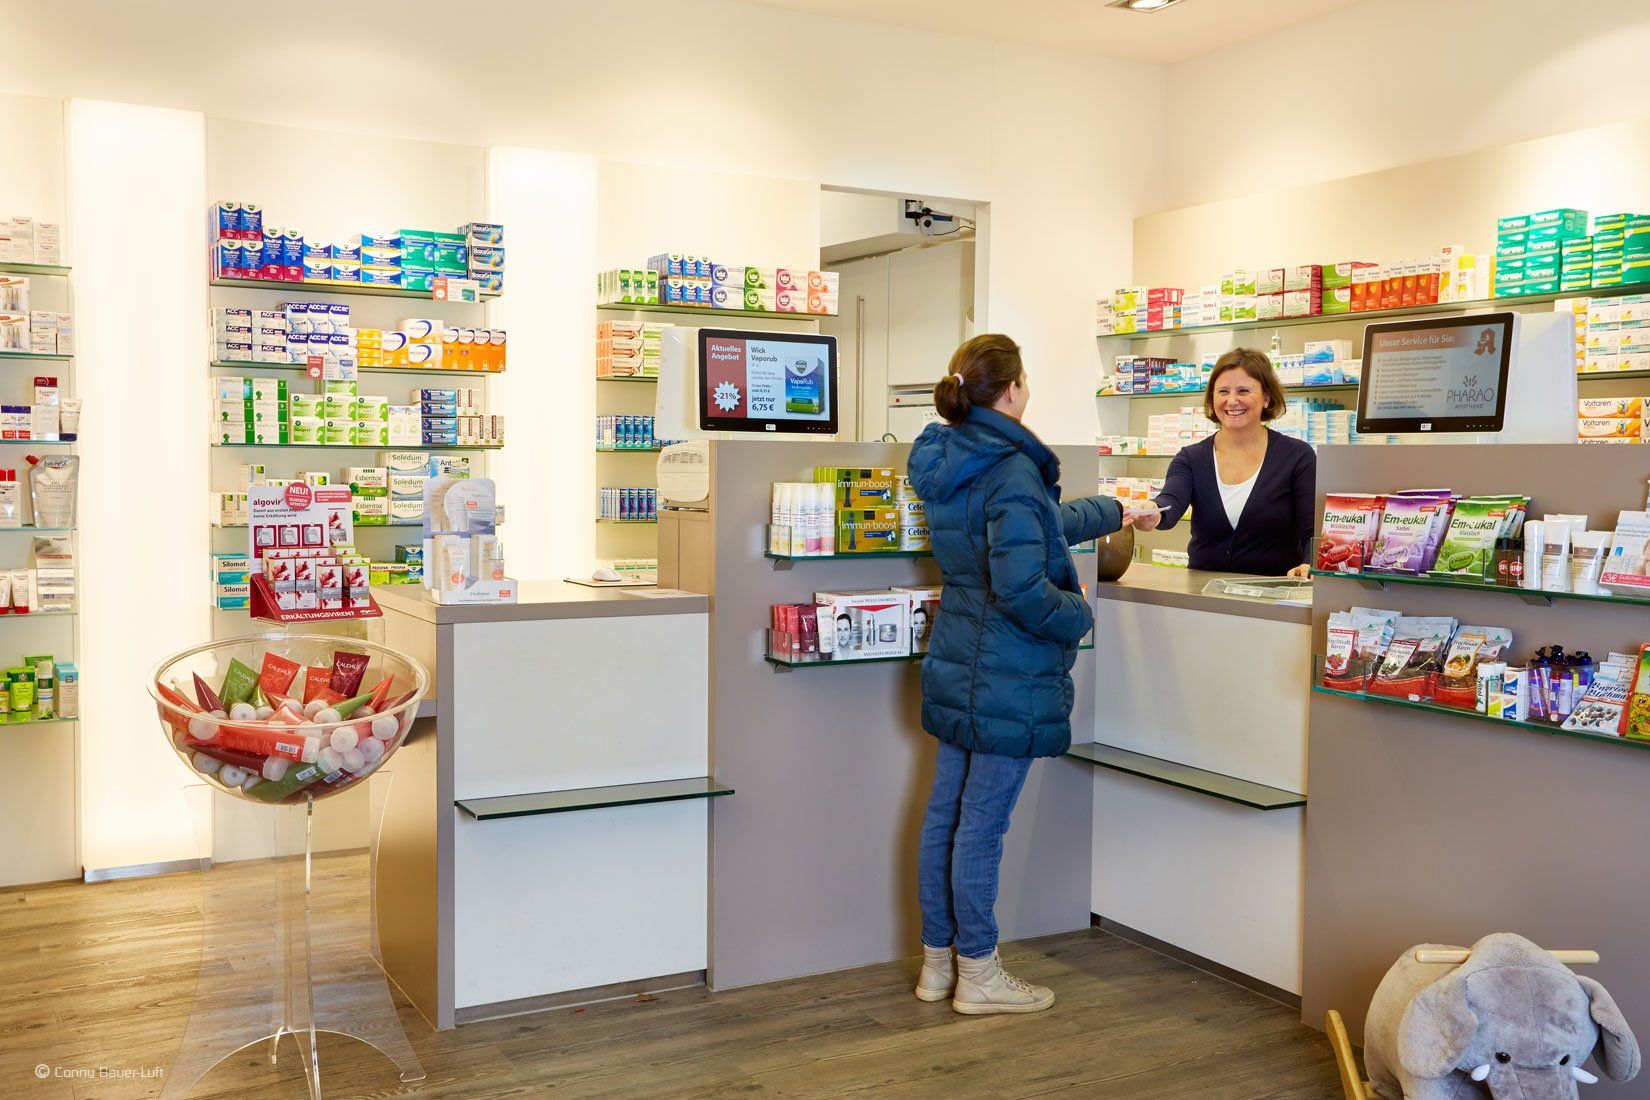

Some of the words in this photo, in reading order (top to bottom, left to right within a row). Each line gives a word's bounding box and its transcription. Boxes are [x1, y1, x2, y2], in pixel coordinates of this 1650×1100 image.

[1380, 338, 1400, 348] Unser
[1401, 336, 1428, 346] Service
[1428, 336, 1440, 344] für
[1441, 334, 1456, 343] Sie:
[711, 345, 741, 353] Aktuelles
[751, 346, 766, 354] Wick
[711, 353, 740, 361] Angebot
[717, 392, 736, 400] -21%
[1446, 388, 1494, 403] PHARAO
[1582, 419, 1611, 427] Voltaren
[289, 486, 308, 496] NEU!
[253, 498, 281, 507] algovir
[1325, 512, 1366, 524] Em-eukal
[1383, 514, 1428, 525] Em-eukal
[1451, 519, 1496, 530] Em-eukal
